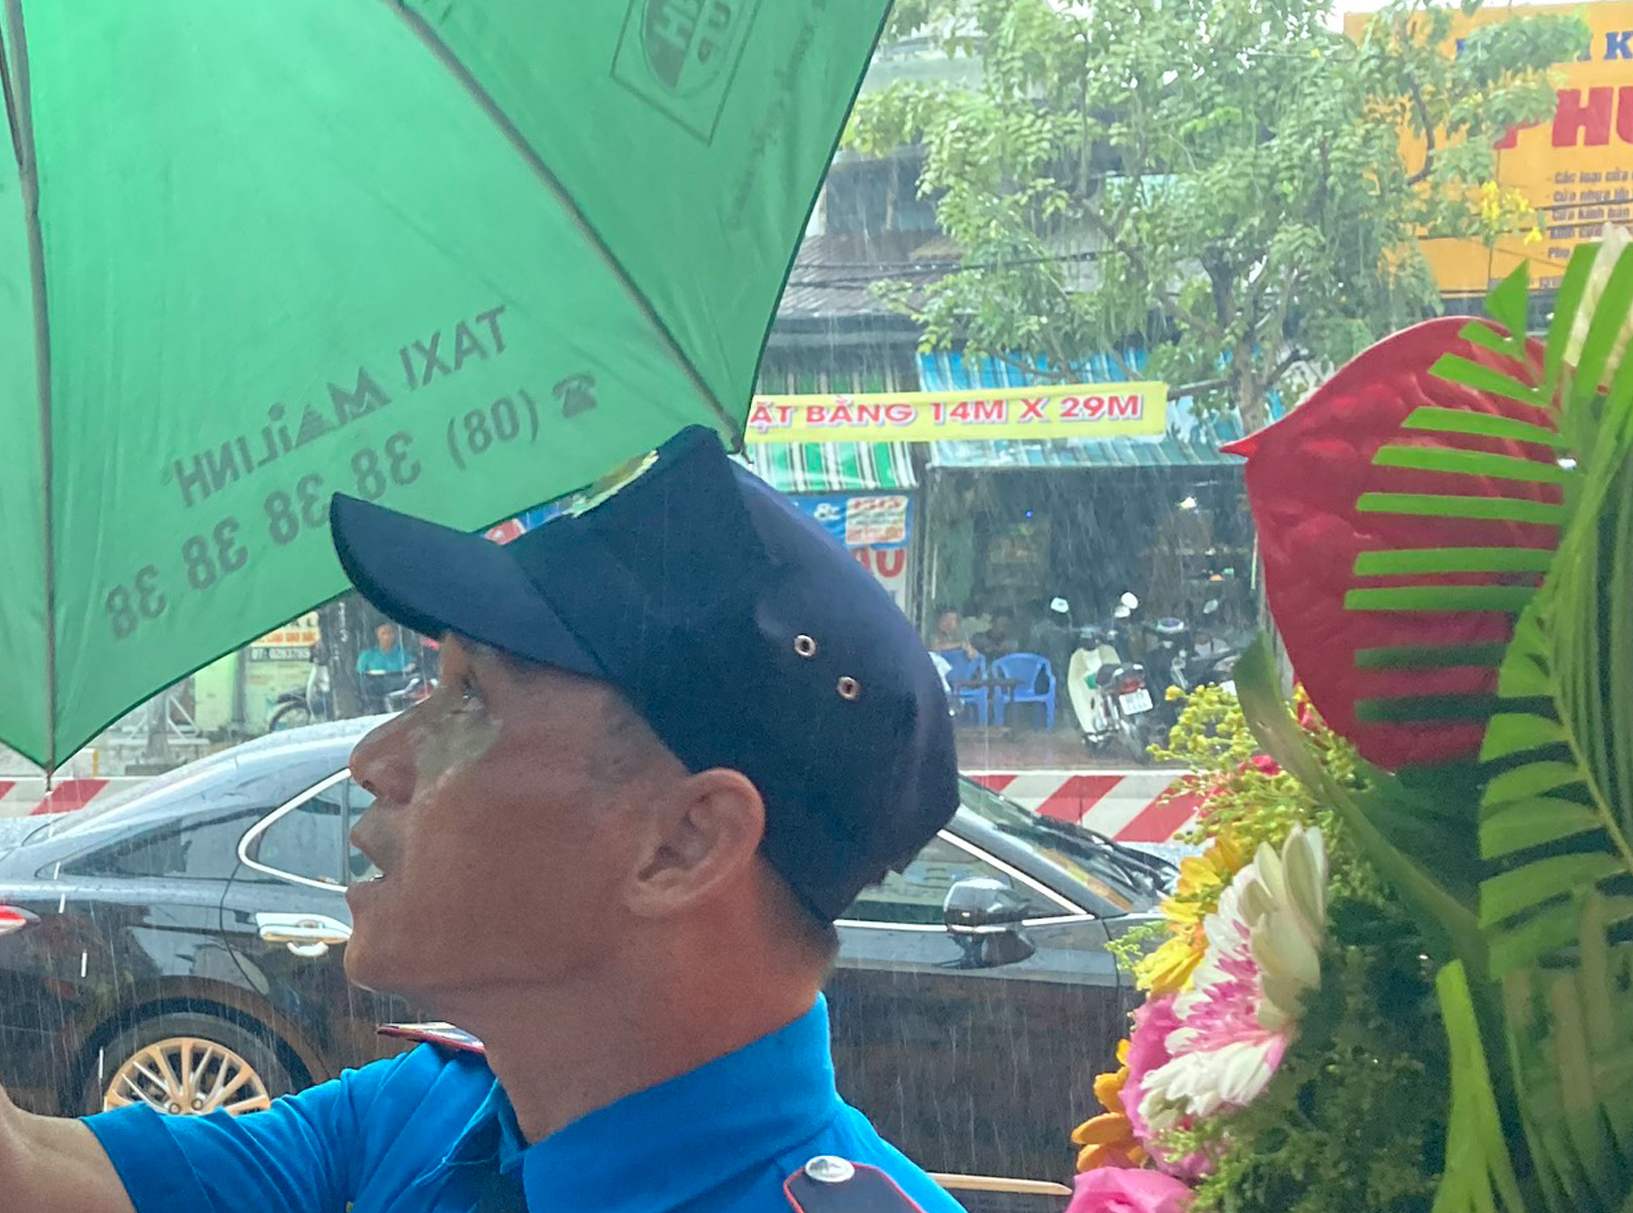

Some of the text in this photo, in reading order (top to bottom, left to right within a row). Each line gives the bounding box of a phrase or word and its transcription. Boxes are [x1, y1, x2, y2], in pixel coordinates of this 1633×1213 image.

[748, 393, 1142, 432] ẶT BẰNG 14M X 29M
